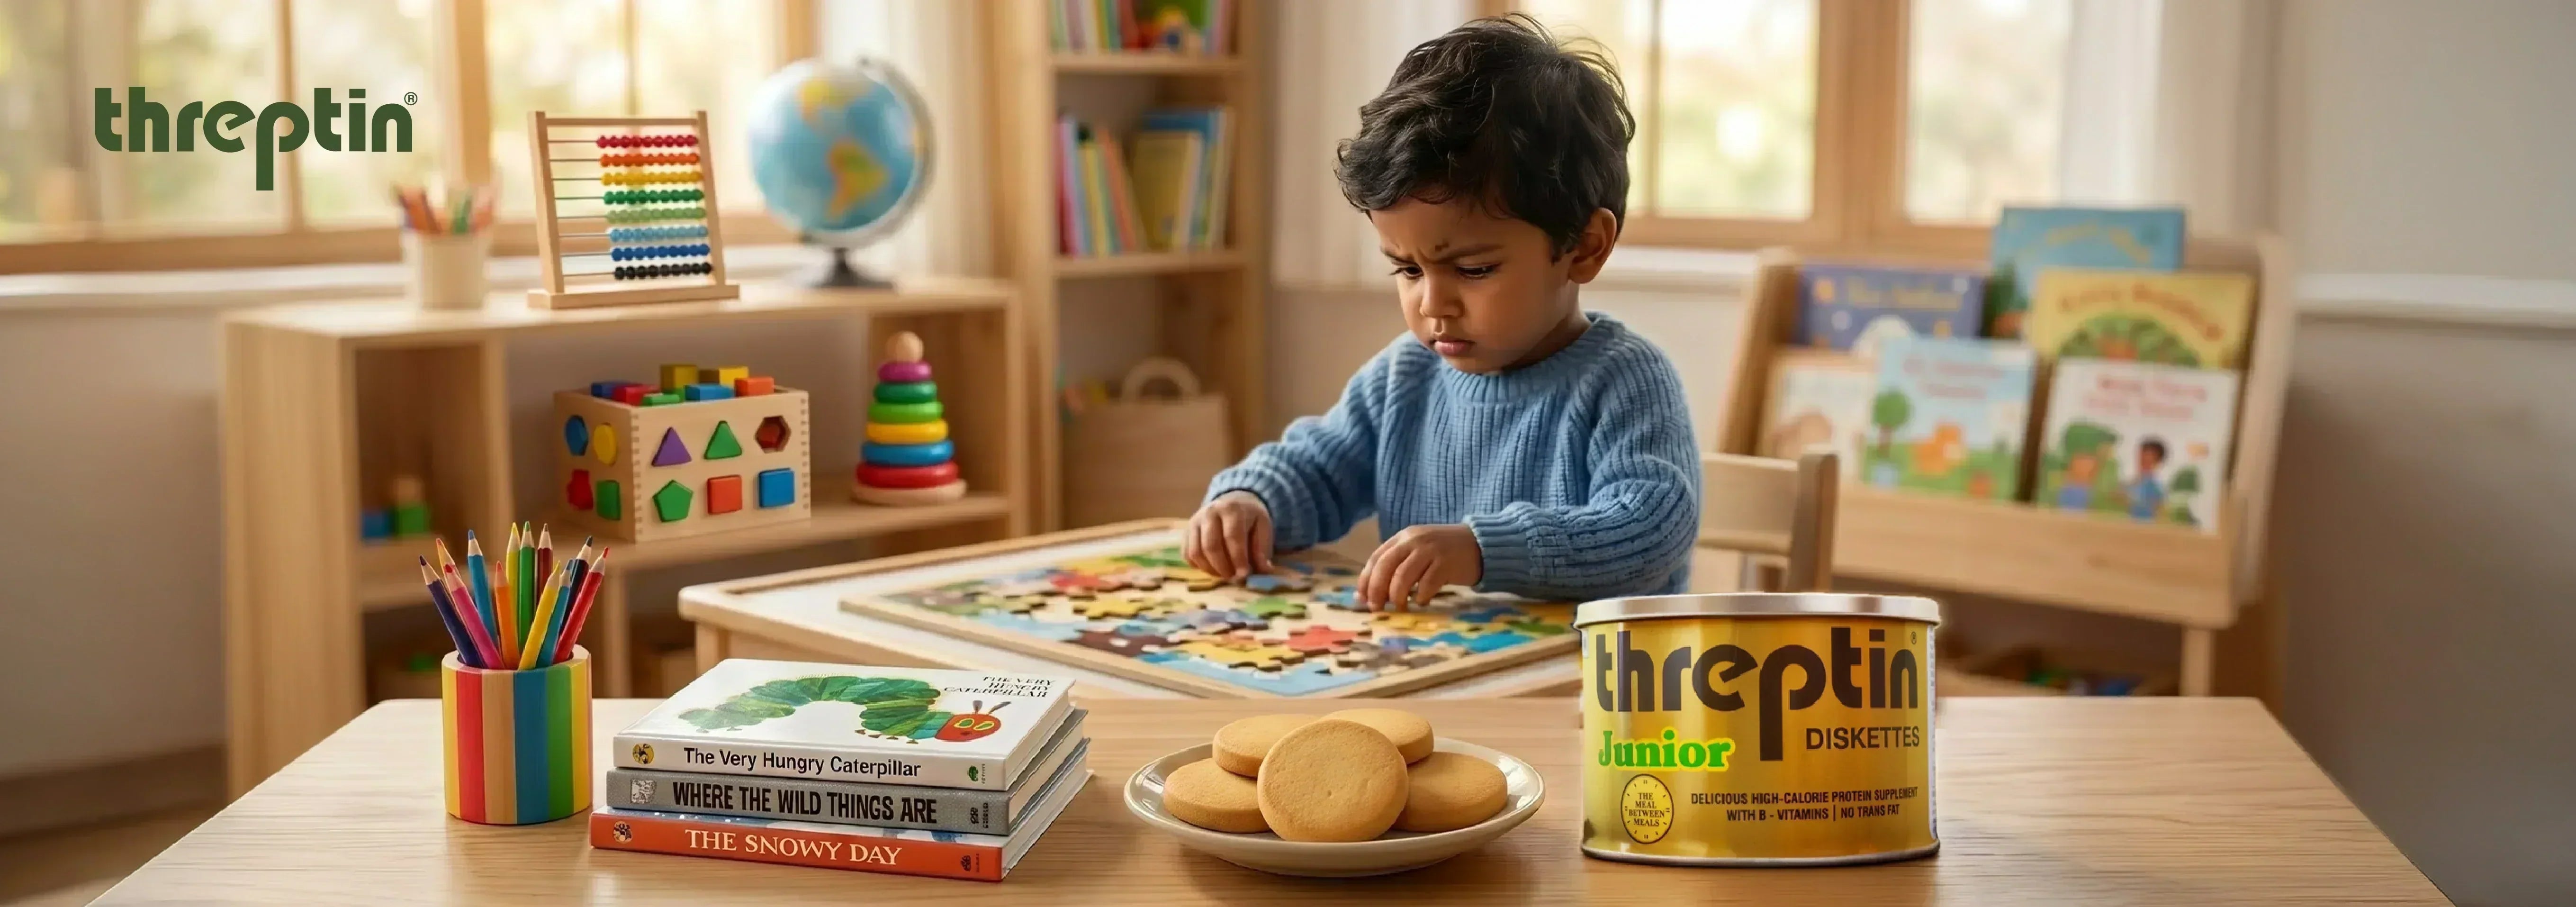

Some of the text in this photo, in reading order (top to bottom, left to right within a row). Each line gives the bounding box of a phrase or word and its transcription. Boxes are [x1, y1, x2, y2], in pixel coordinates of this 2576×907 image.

[1598, 728, 1731, 768] Junior
[1805, 726, 1920, 751] DISKETTES
[684, 747, 922, 779] The Very Hungry Caterpillar
[673, 782, 937, 824] WHERE THE WILD THINGS ARE
[1635, 801, 1657, 809] MEAL
[1691, 787, 1918, 805] DELICIOUS HIGH-CALORIE PROTEIN SUPPLEMENT
[1629, 809, 1665, 818] BETWEEN
[1633, 818, 1659, 827] MEALS
[1726, 809, 1756, 821] WITH
[1777, 808, 1829, 821] VITAMINS
[1841, 807, 1855, 819] NO
[1857, 805, 1886, 817] TRANS
[1888, 804, 1900, 816] FAT
[685, 829, 902, 866] THE SNOWY DAY
